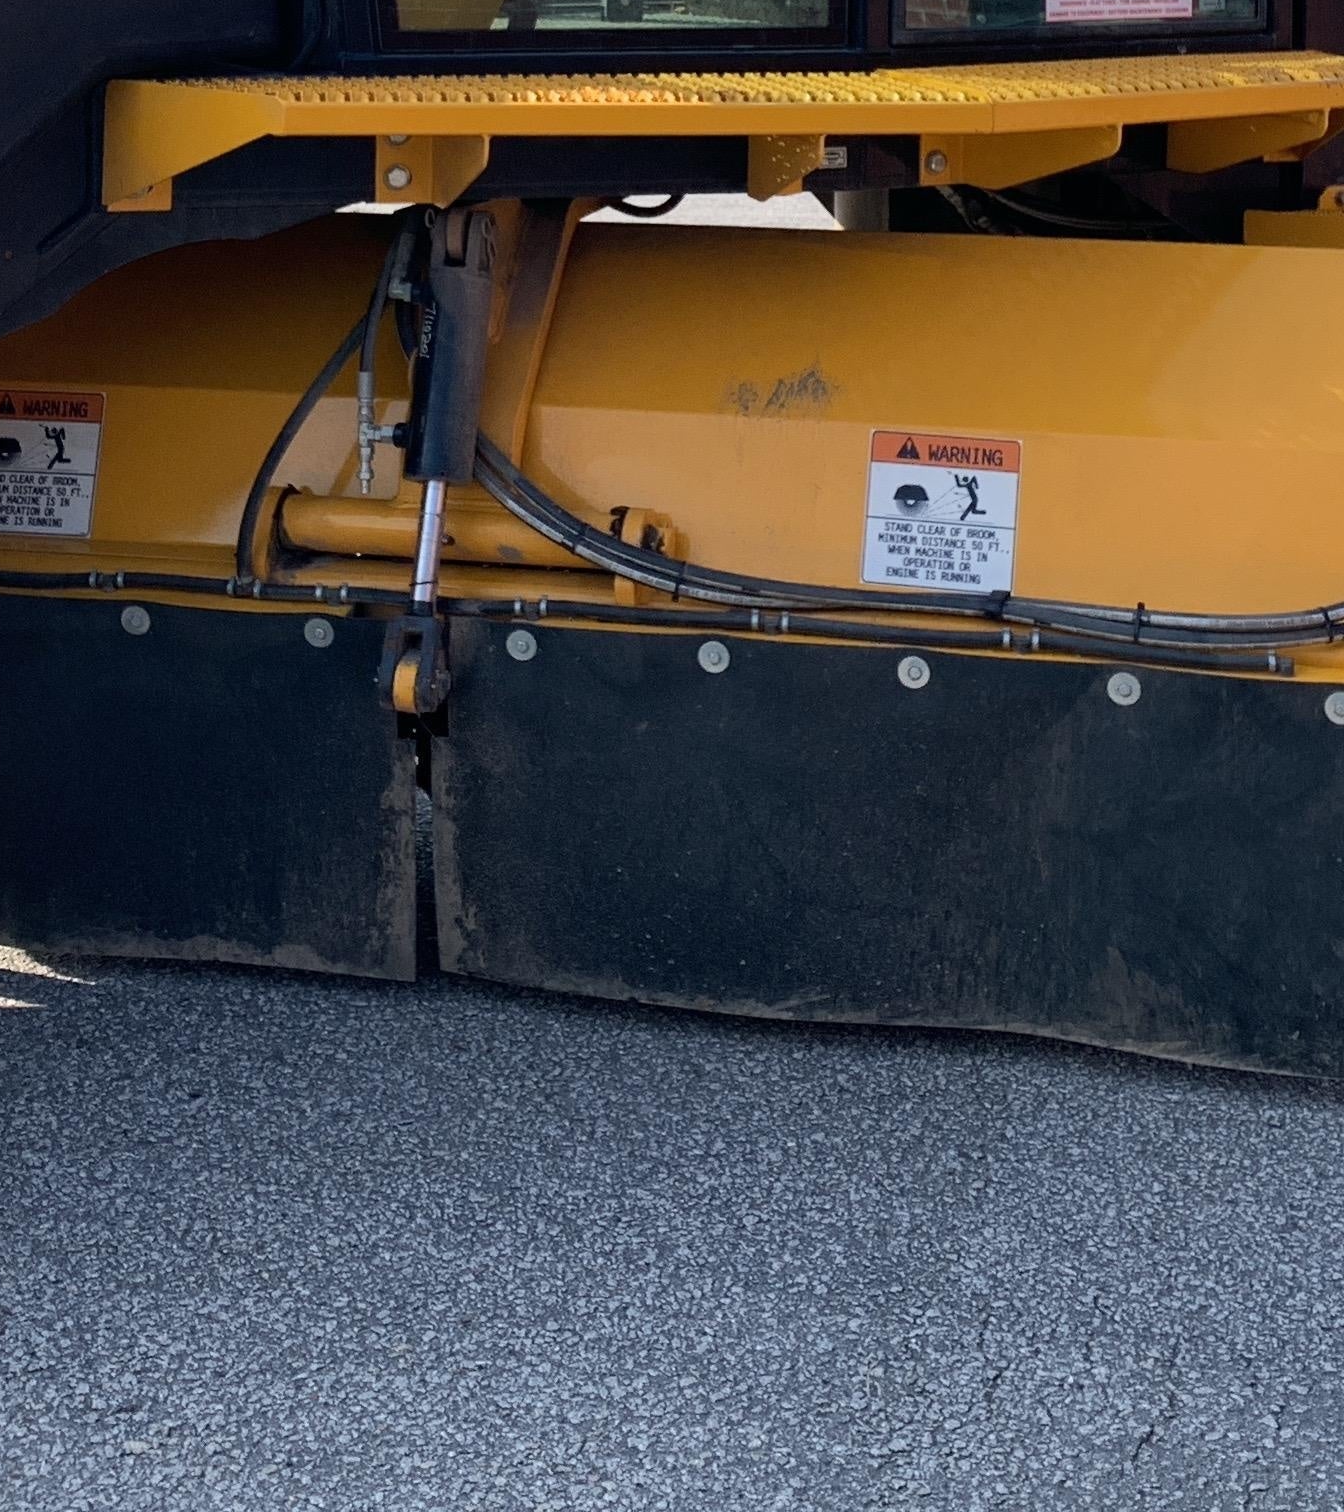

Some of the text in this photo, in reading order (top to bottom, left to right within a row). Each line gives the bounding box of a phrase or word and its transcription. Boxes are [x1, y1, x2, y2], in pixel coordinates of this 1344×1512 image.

[22, 399, 88, 418] WARNING
[928, 444, 1003, 467] WARNING
[9, 474, 35, 484] CLEAR
[38, 476, 49, 485] OF
[13, 485, 51, 496] DISTANCE
[6, 495, 41, 506] MACHINE
[46, 497, 55, 507] IS
[60, 498, 70, 507] IN
[44, 507, 55, 517] OR
[14, 516, 24, 525] IS
[28, 517, 63, 528] RUNNING
[884, 522, 912, 533] STAND
[917, 524, 946, 535] CLEAR
[950, 527, 962, 537] OF
[878, 533, 917, 545] MINIMUM
[921, 536, 966, 549] DISTANCE
[972, 541, 983, 550] 50
[887, 544, 988, 562] WHEN MACHINE IS IN
[903, 557, 971, 572] OPERATION OR
[886, 567, 981, 585] ENGINE IS RUNNING
